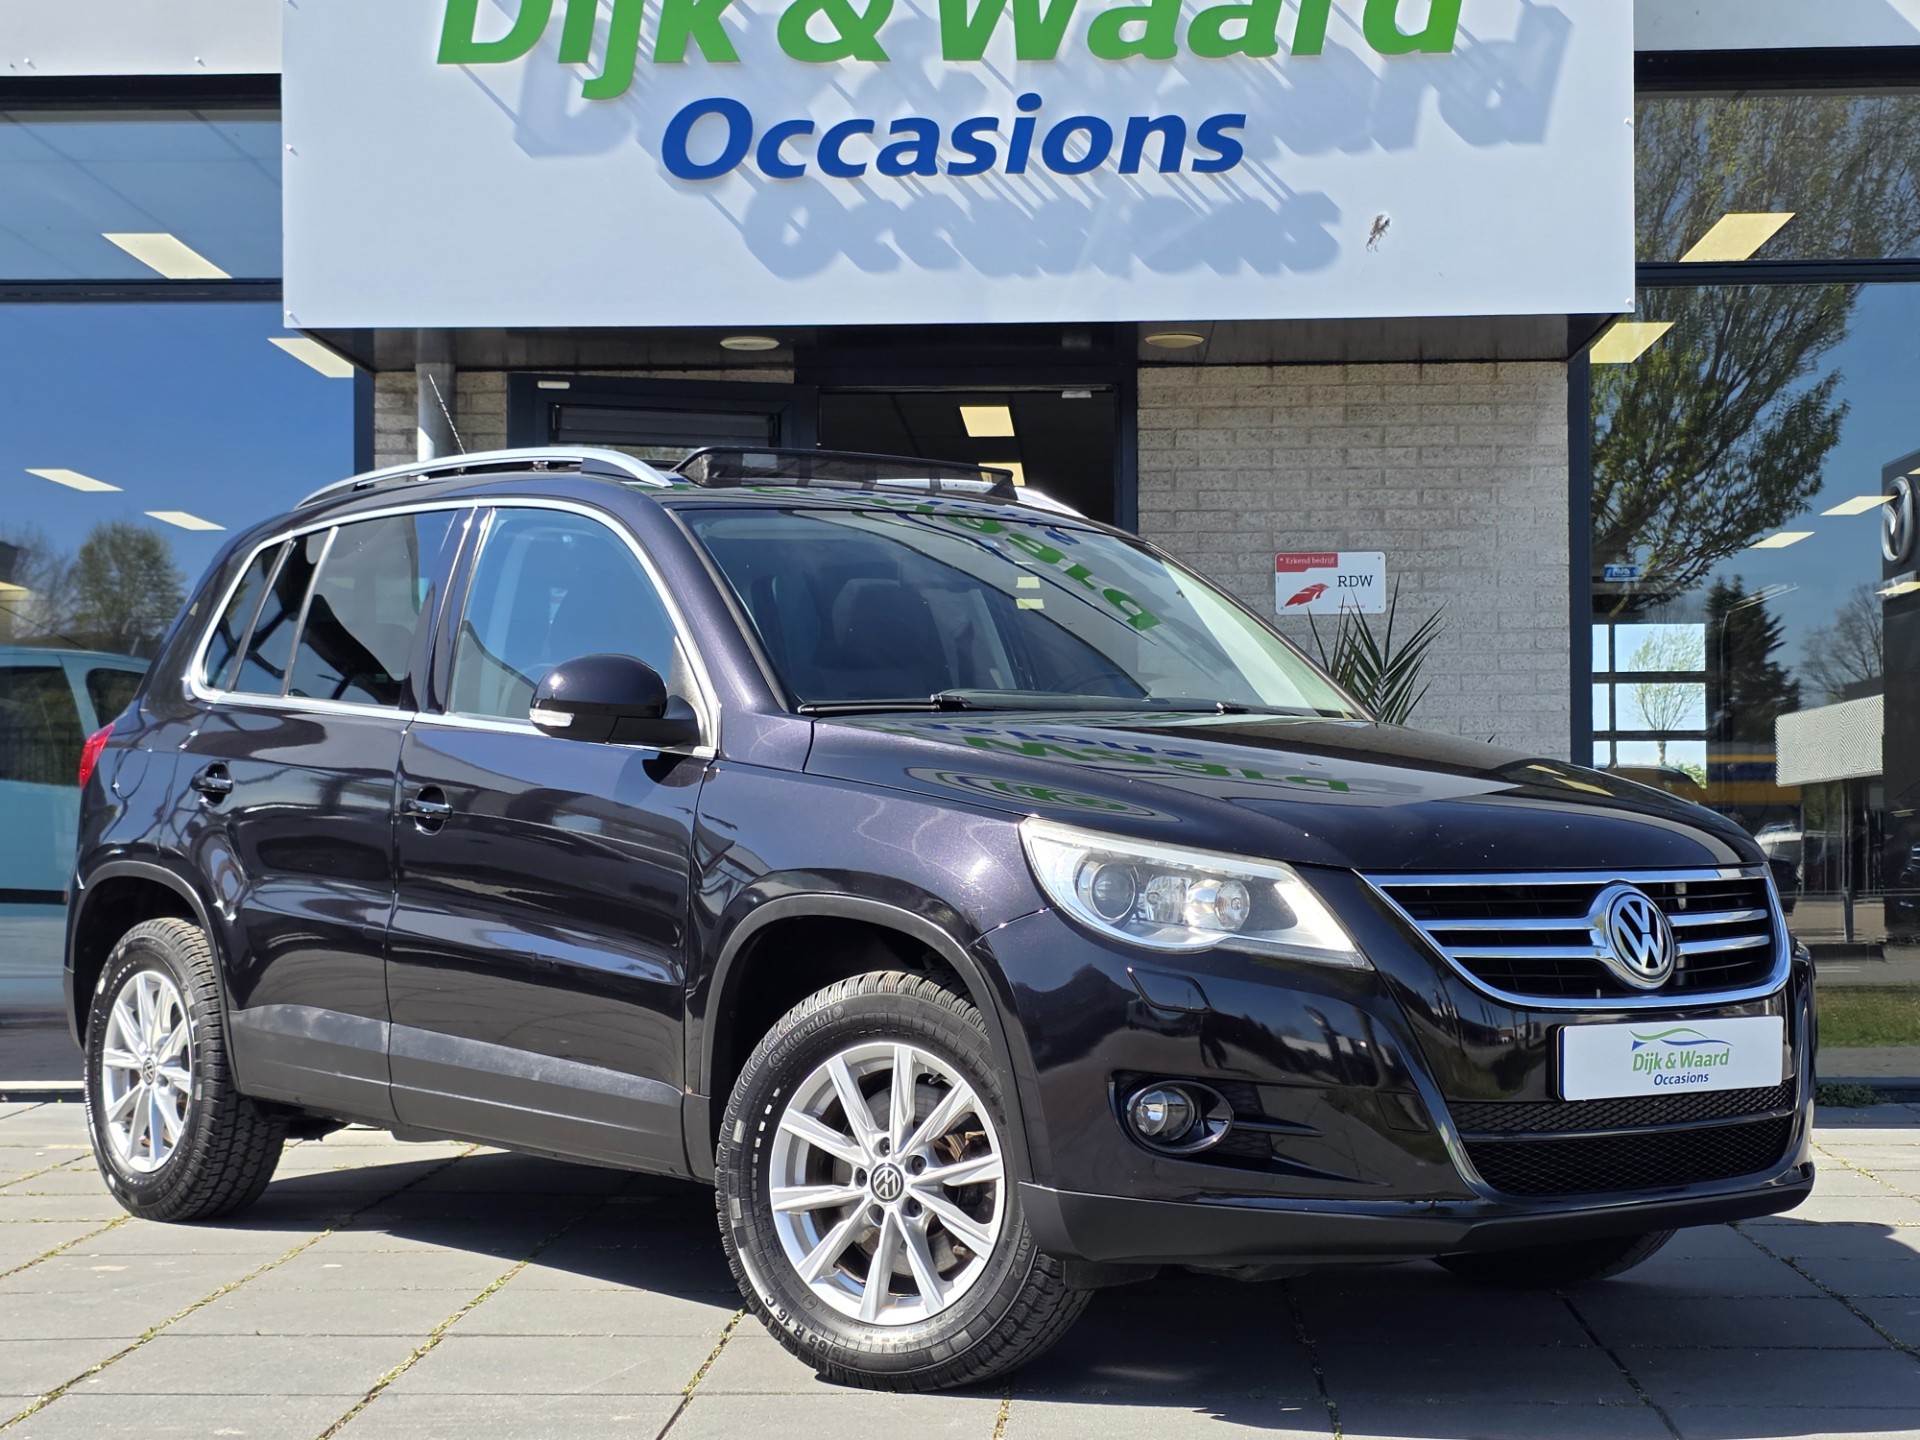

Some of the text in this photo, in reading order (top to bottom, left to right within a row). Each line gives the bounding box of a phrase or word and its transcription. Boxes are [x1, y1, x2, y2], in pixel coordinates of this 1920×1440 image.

[661, 93, 1246, 181] Occasions
[1285, 556, 1335, 565] Erkend bedrijf
[1337, 575, 1373, 587] RDW
[1632, 1047, 1730, 1075] Dijk & Waard
[1654, 1071, 1709, 1085] Occasions
